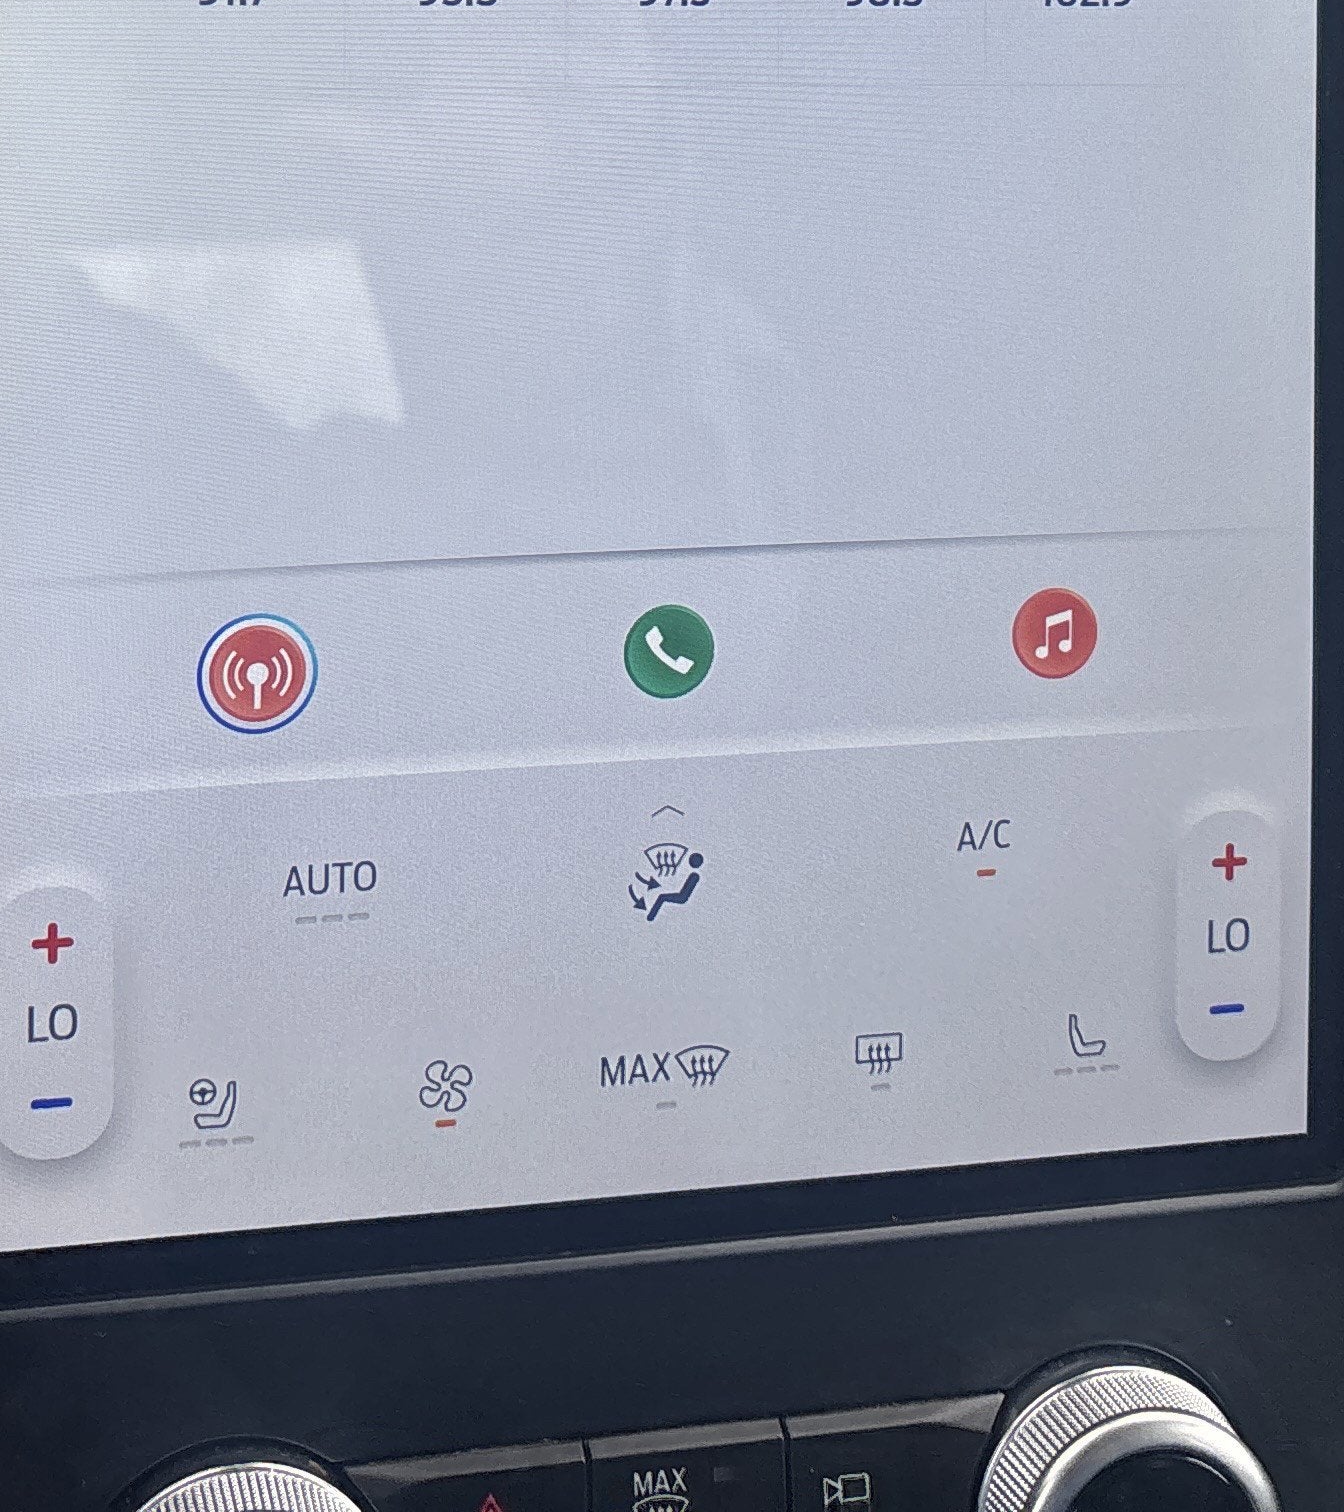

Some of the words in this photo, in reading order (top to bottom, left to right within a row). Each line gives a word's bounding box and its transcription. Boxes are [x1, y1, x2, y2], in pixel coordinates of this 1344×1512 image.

[957, 819, 1011, 852] A/C
[282, 860, 378, 898] AUTO
[1208, 917, 1250, 954] LO
[27, 1003, 79, 1043] LO
[600, 1052, 671, 1088] MAX
[633, 1467, 688, 1496] MAX
